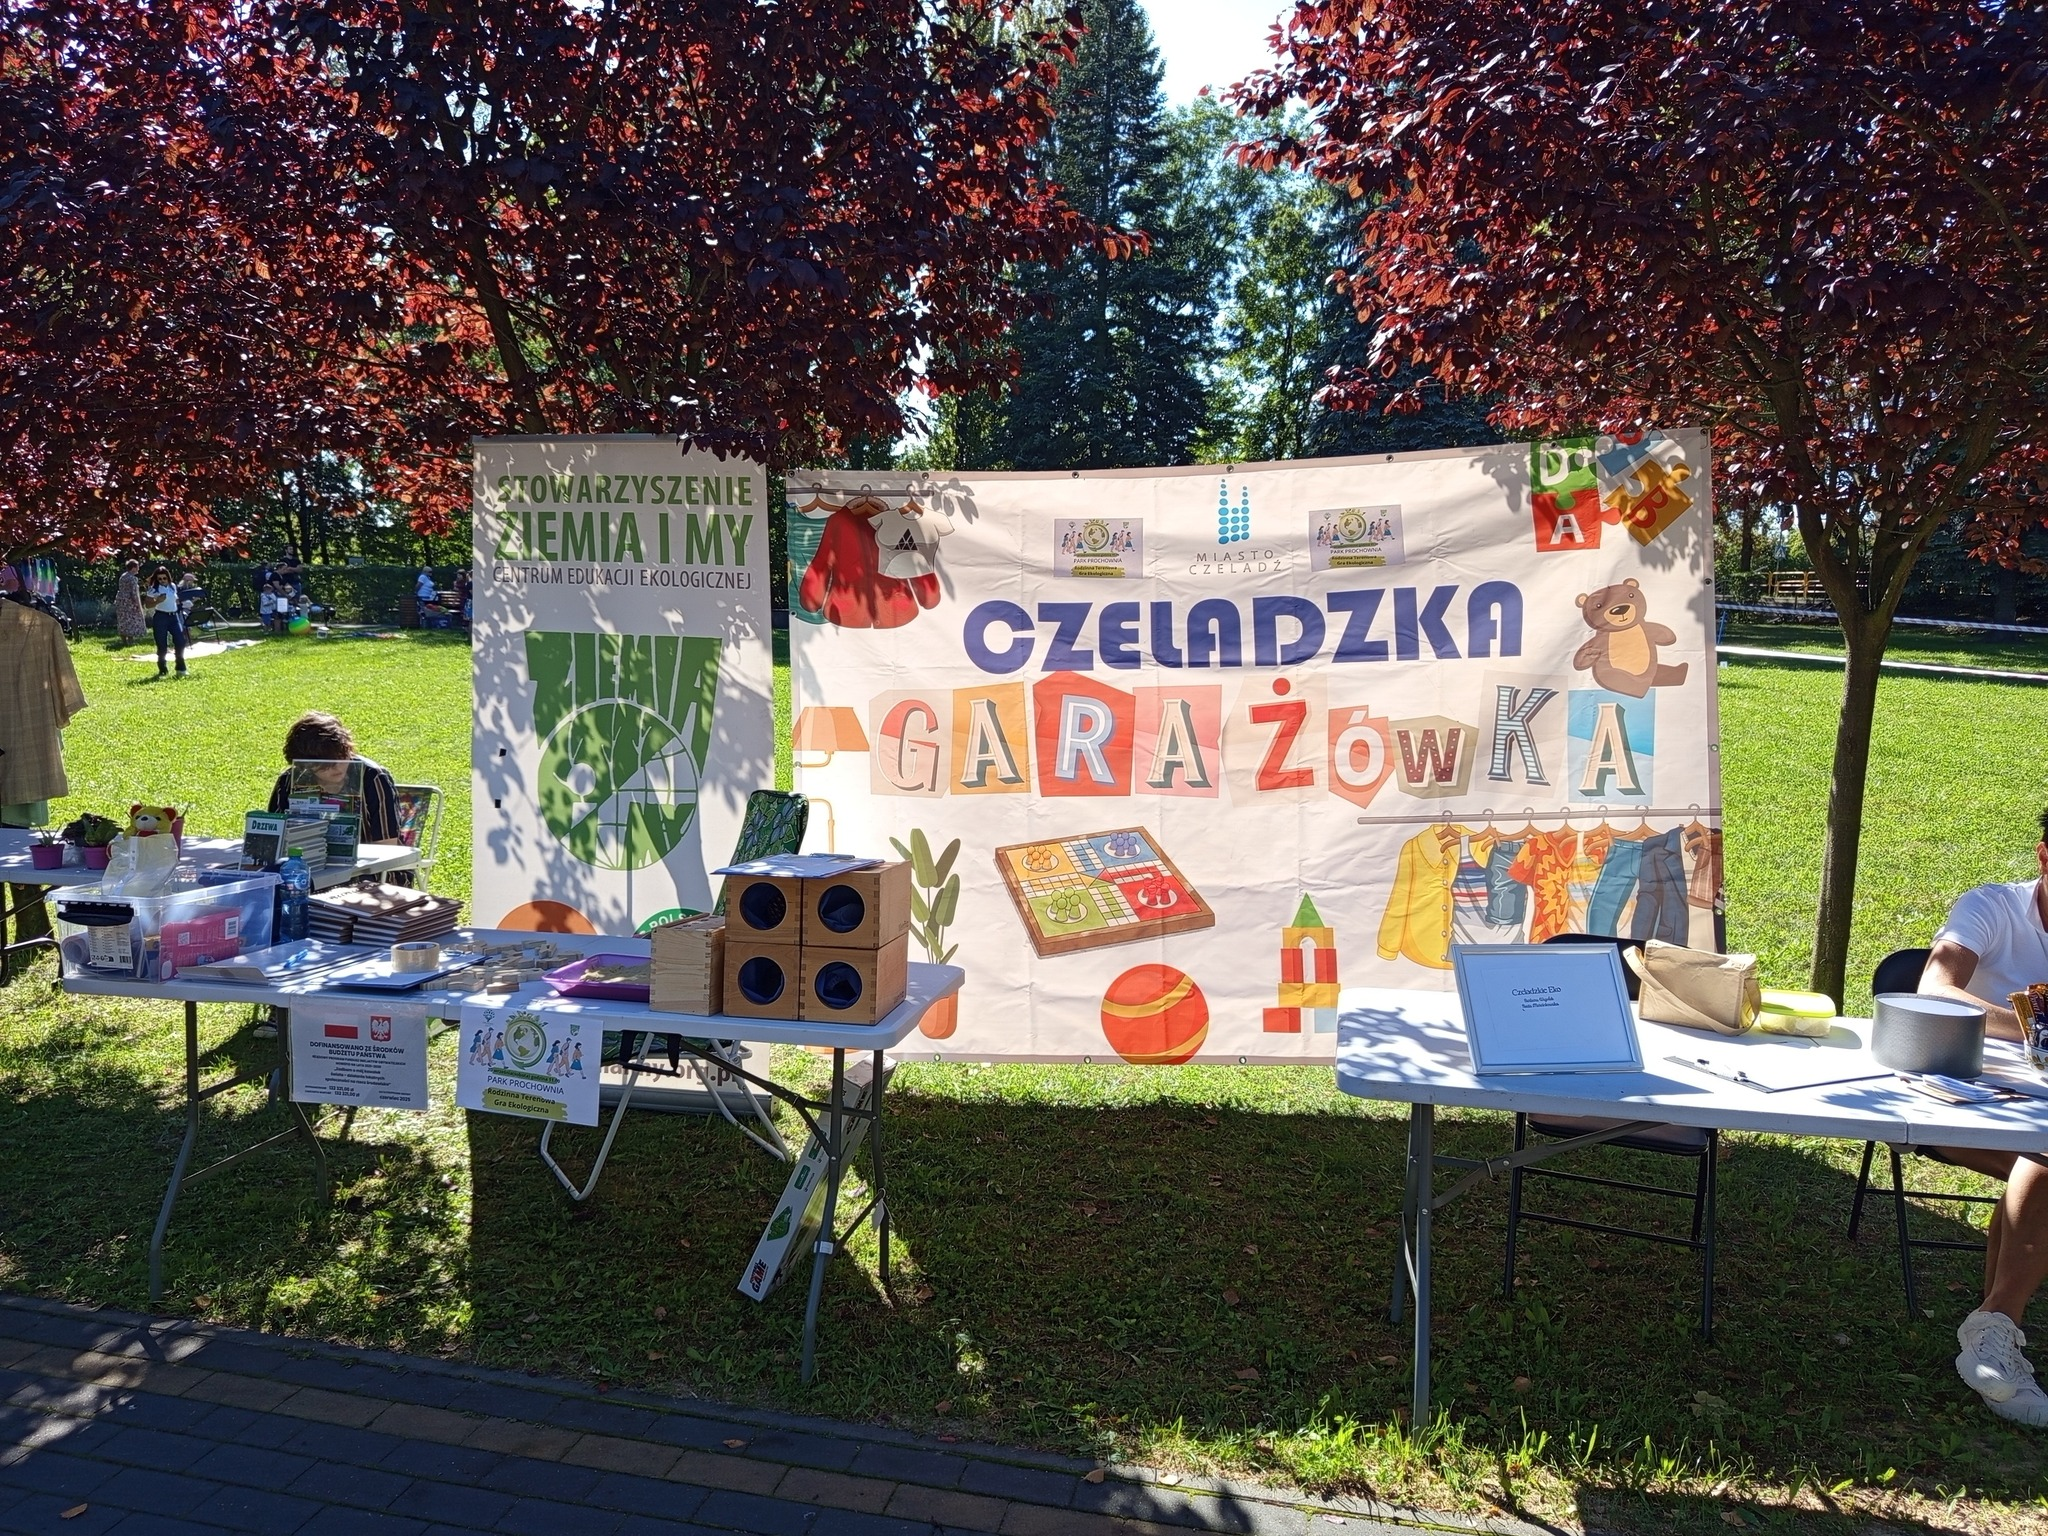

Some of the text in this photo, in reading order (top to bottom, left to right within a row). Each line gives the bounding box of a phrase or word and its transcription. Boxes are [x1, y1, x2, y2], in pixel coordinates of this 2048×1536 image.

[497, 475, 753, 506] STOWARZYSZENIE
[494, 511, 754, 566] ZIEMIA I MY
[1196, 549, 1274, 562] MIASTO
[1189, 559, 1282, 575] CZELADŹ
[493, 566, 752, 590] CENTRUM EDUKACJI EKOLOGICZNEJ
[963, 580, 1524, 675] CZELADZKA
[251, 820, 278, 832] DRZEWA
[310, 1041, 363, 1051] DOFINANSOWANO
[373, 1044, 404, 1054] ŚRODKÓW
[329, 1049, 387, 1059] BUDŻETU PAŃSTWA
[487, 1075, 508, 1086] PARK
[509, 1078, 564, 1095] PROCHOWNIA
[487, 1087, 556, 1105] Rodzinna Terenowa
[494, 1099, 549, 1114] Gra Ekologiczna
